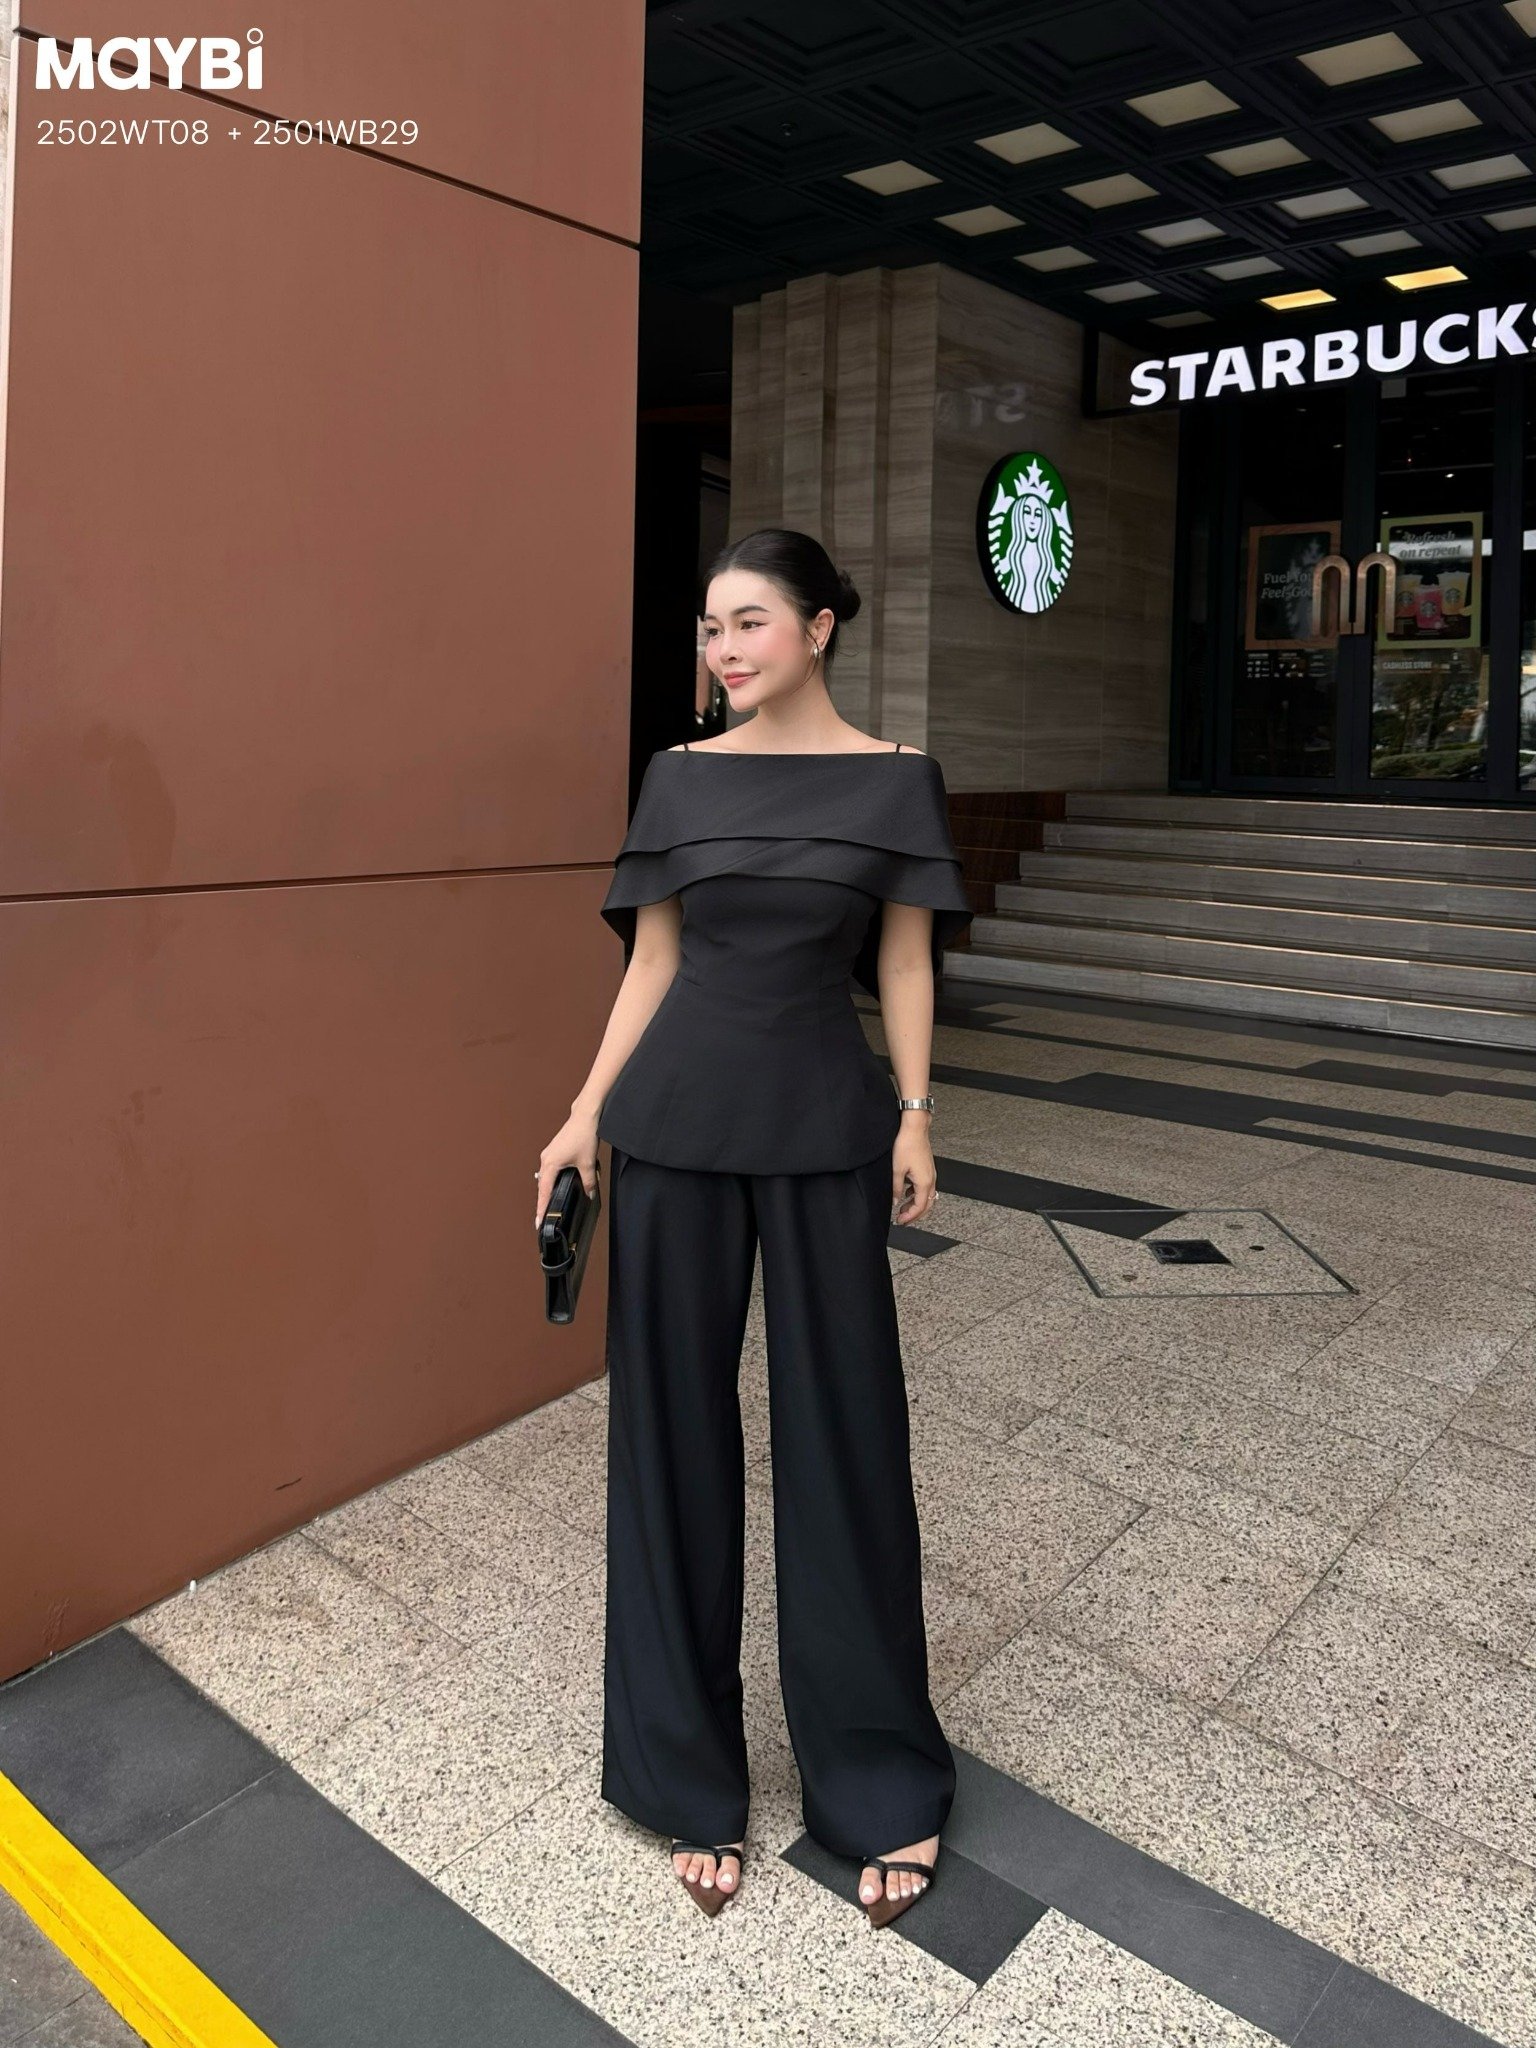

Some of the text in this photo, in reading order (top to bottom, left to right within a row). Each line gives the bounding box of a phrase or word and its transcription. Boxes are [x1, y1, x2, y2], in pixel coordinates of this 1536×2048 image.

[1129, 302, 1536, 408] STARBUCK
[1418, 545, 1462, 559] repeat
[1263, 571, 1290, 585] Fuel
[1261, 585, 1286, 599] Feel
